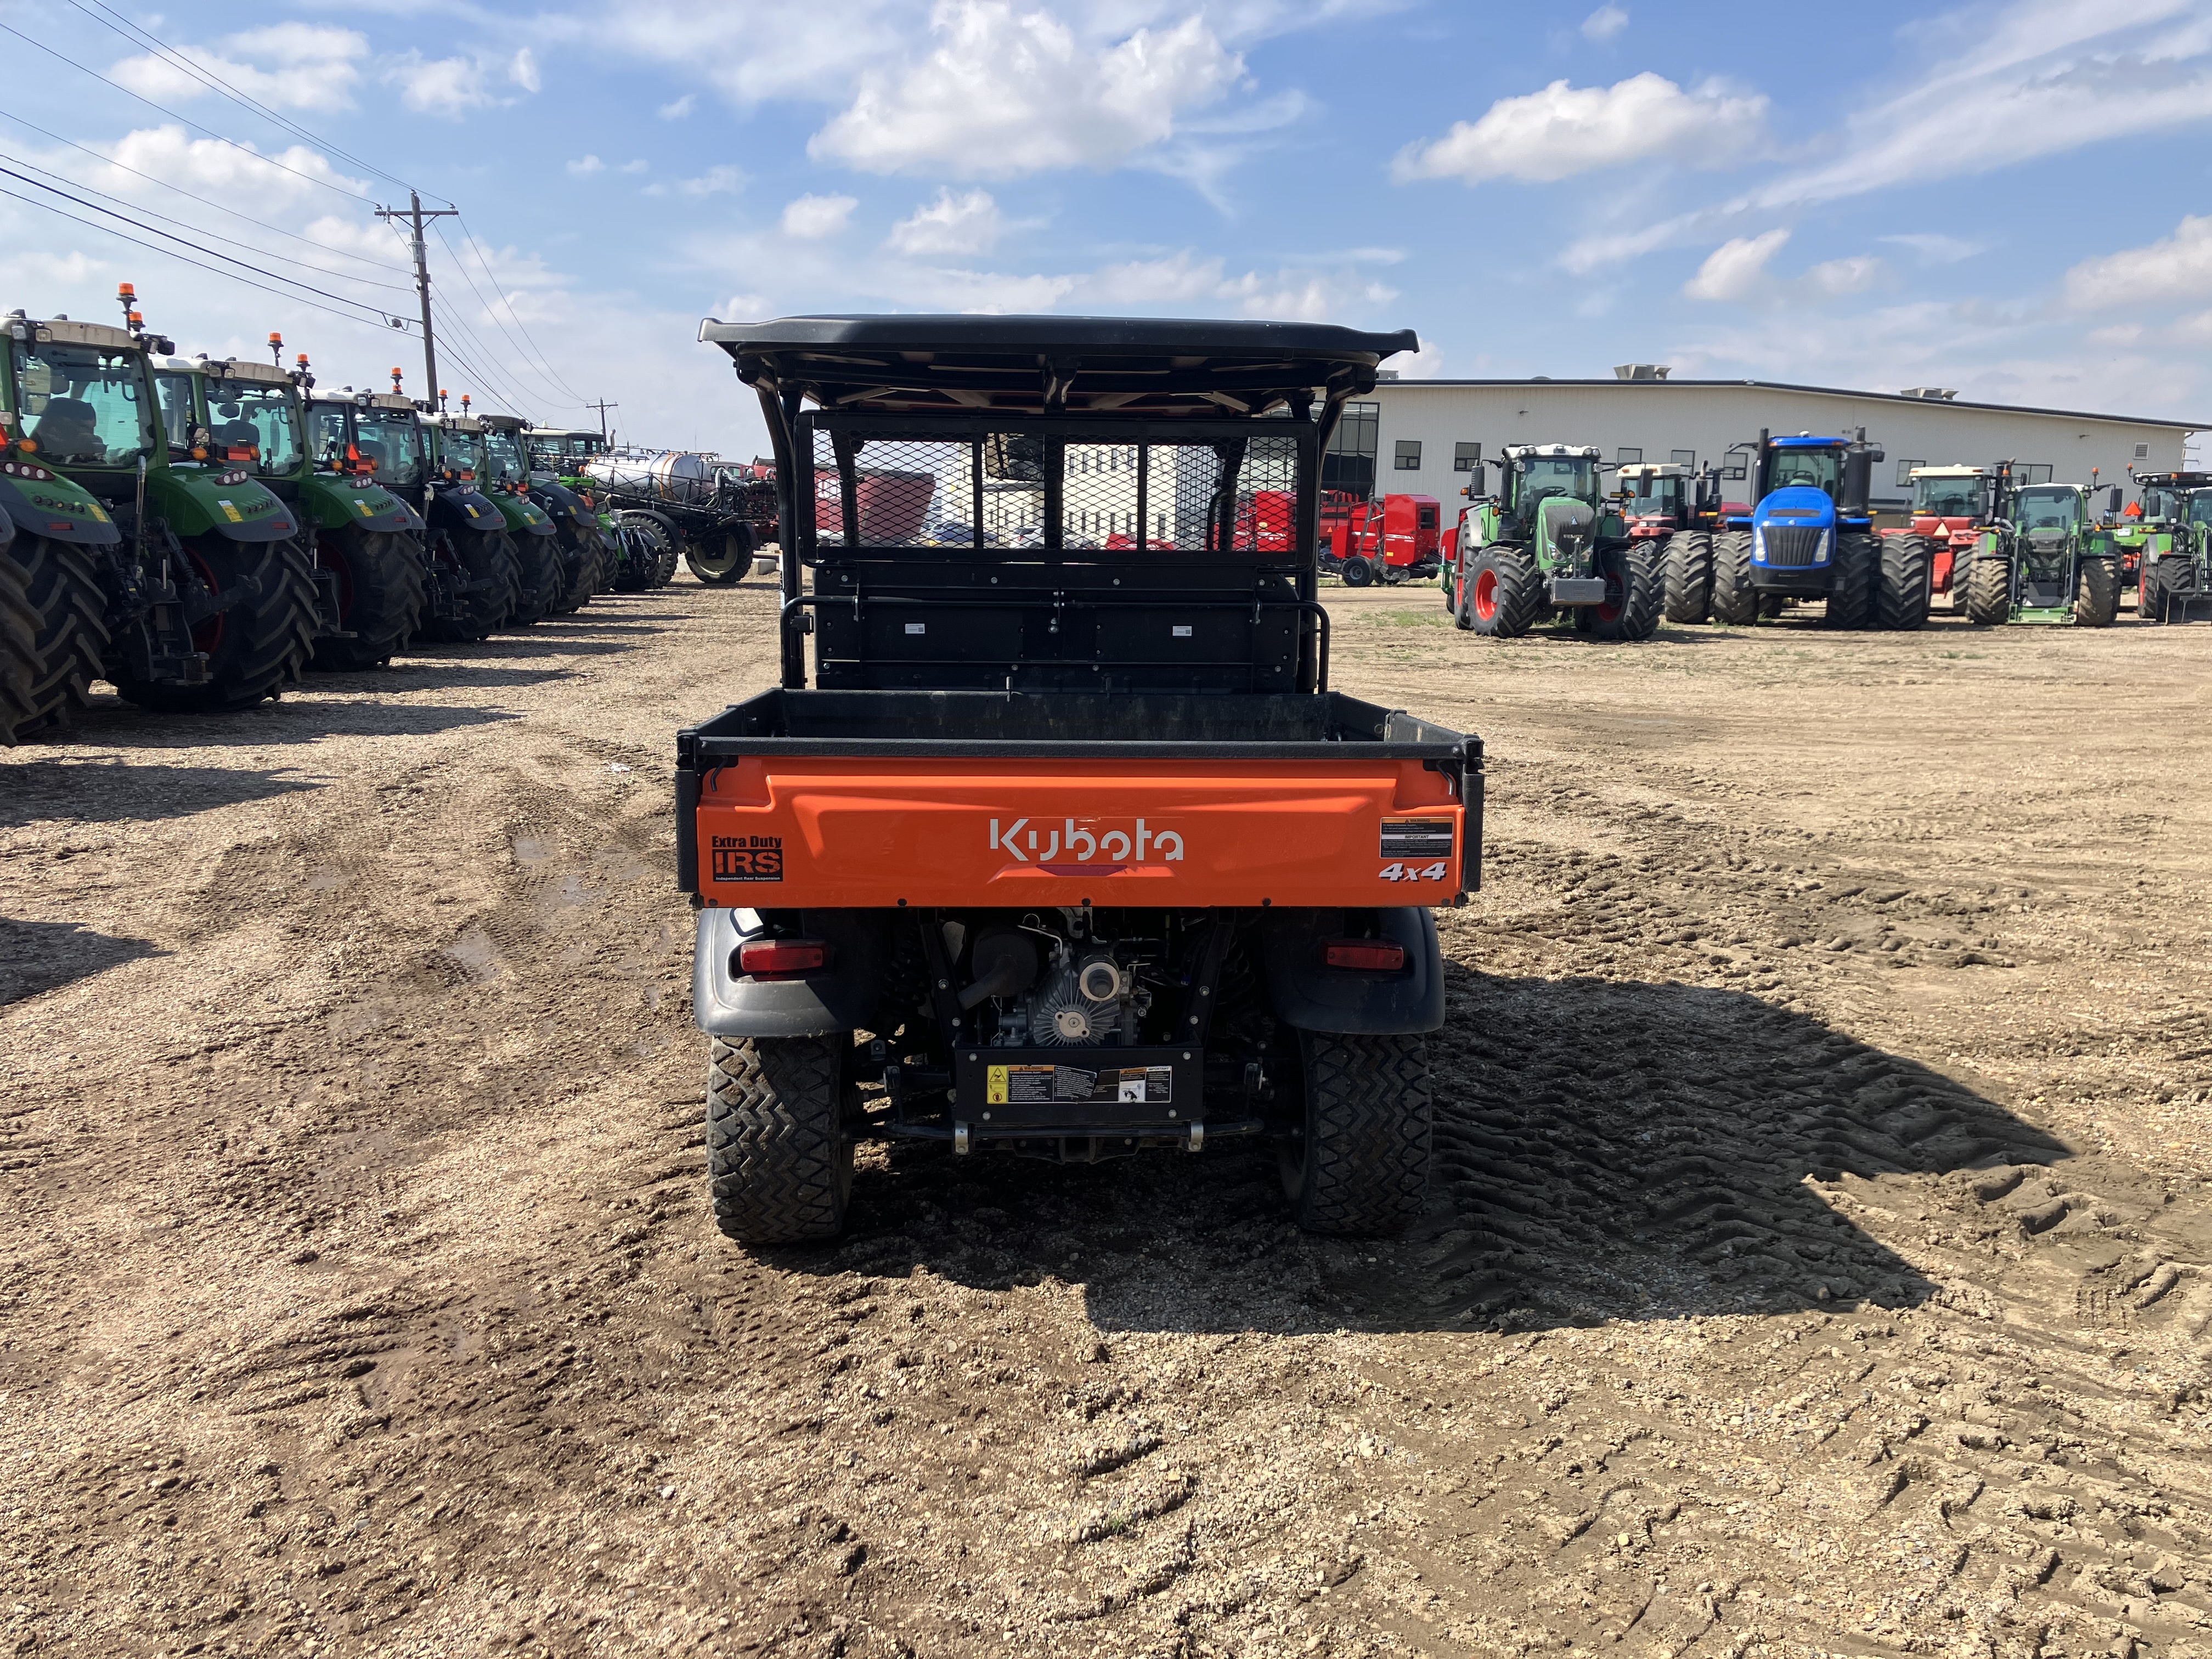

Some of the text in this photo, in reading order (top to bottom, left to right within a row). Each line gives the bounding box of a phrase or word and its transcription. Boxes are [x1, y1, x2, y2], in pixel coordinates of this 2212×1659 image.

[712, 836, 782, 849] Extra Duty
[990, 818, 1184, 861] Kubota
[715, 851, 781, 873] IRS
[1378, 862, 1447, 882] 4x4
